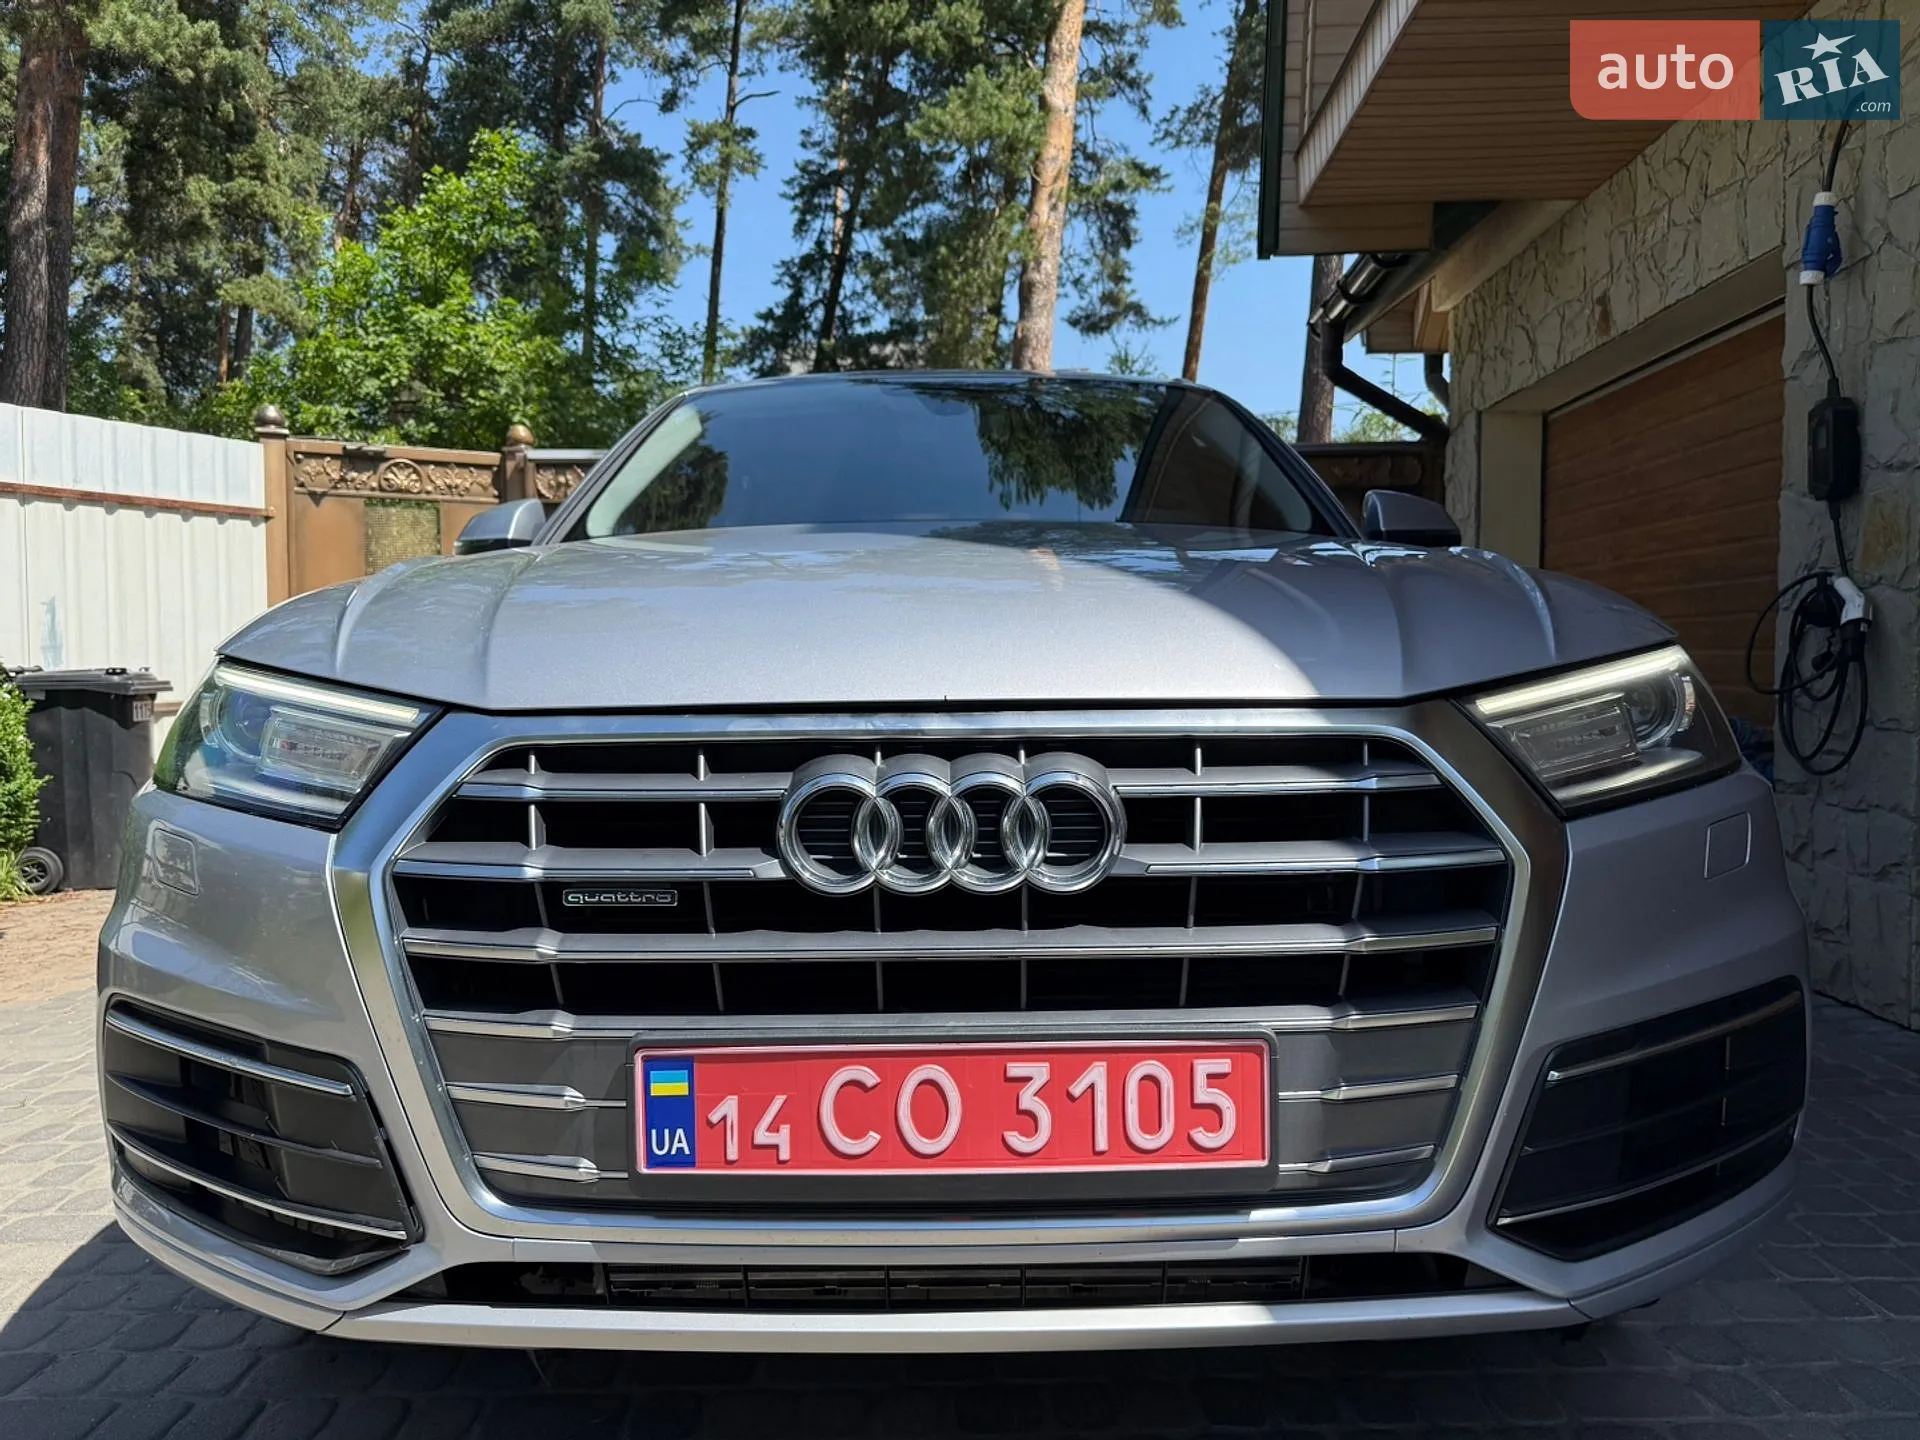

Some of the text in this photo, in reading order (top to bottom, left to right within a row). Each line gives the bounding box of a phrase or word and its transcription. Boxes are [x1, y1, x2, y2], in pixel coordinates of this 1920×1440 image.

[567, 892, 671, 904] quattro
[707, 1058, 1237, 1161] 14 CO 3105
[652, 1128, 691, 1156] UA
